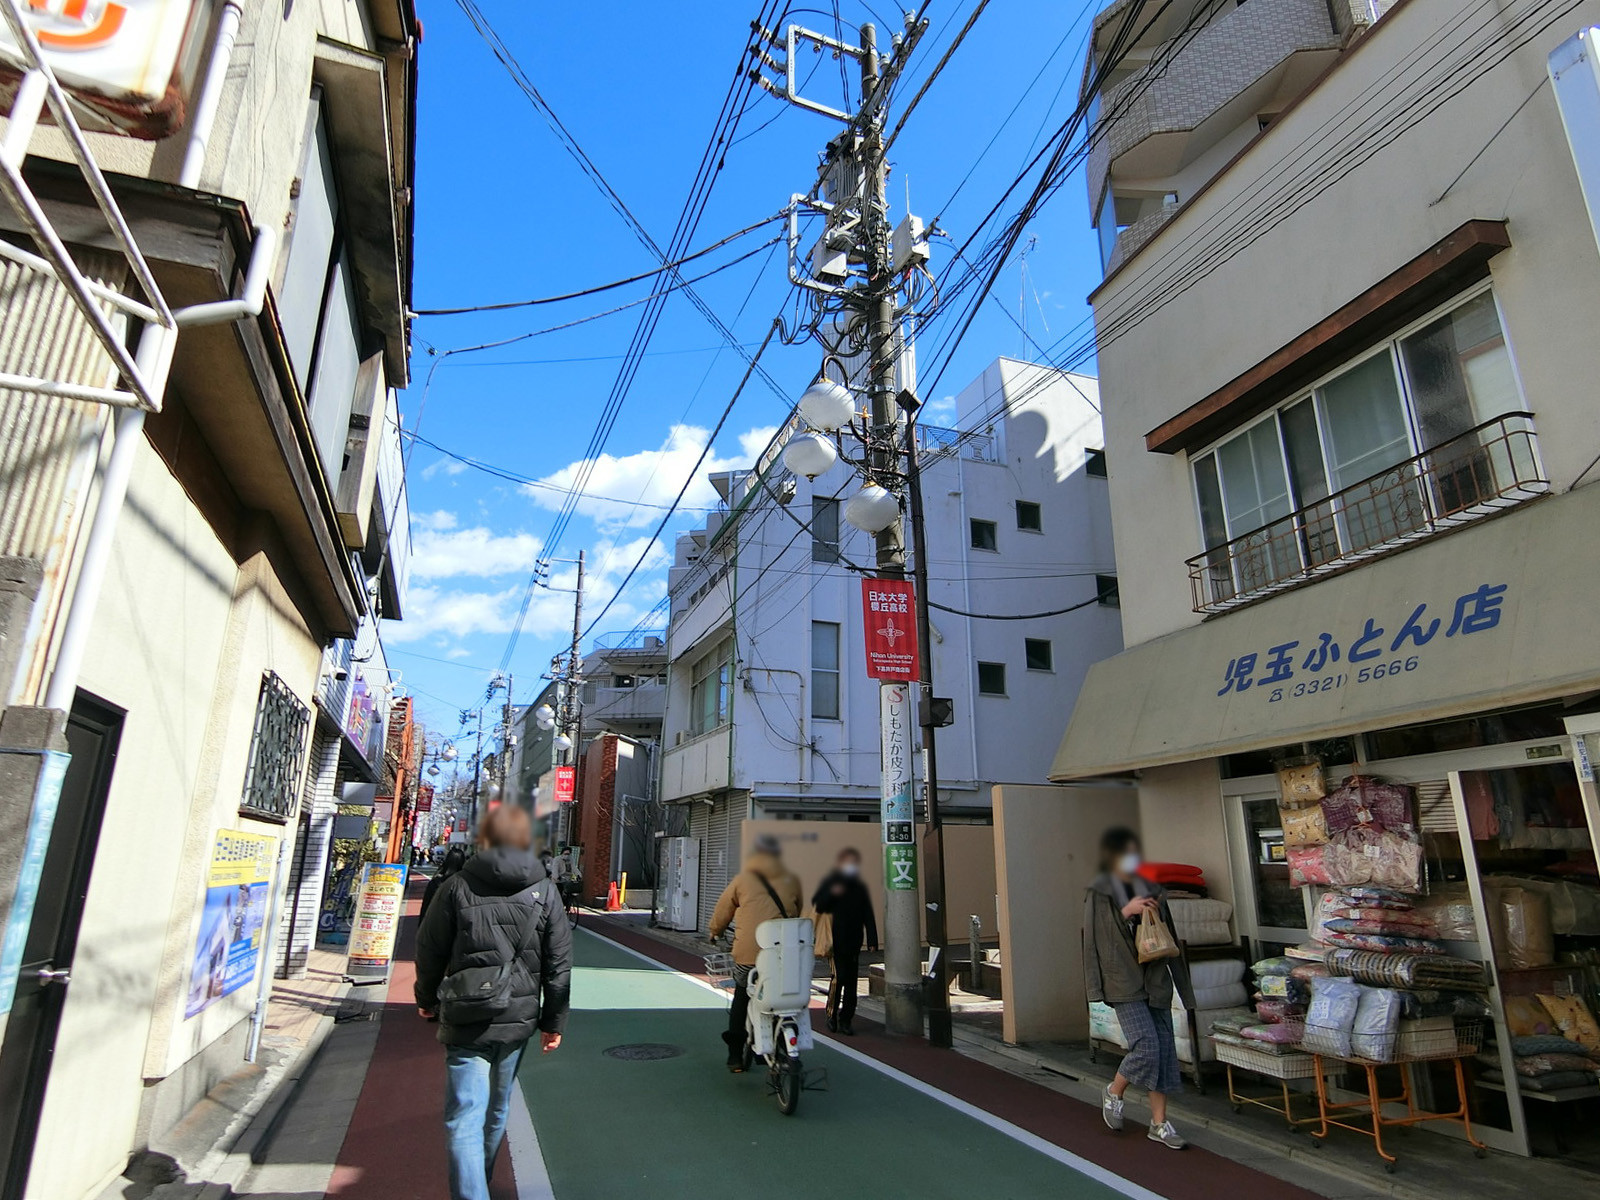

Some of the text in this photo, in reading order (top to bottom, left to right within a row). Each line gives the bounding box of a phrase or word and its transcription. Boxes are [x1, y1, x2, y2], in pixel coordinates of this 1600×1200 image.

[869, 591, 908, 602] 日本大学
[1217, 584, 1508, 697] 児玉ふとん店
[887, 653, 914, 661] University
[1357, 655, 1420, 684] 5666
[889, 704, 904, 795] しもたか皮フ科
[892, 858, 914, 882] 文
